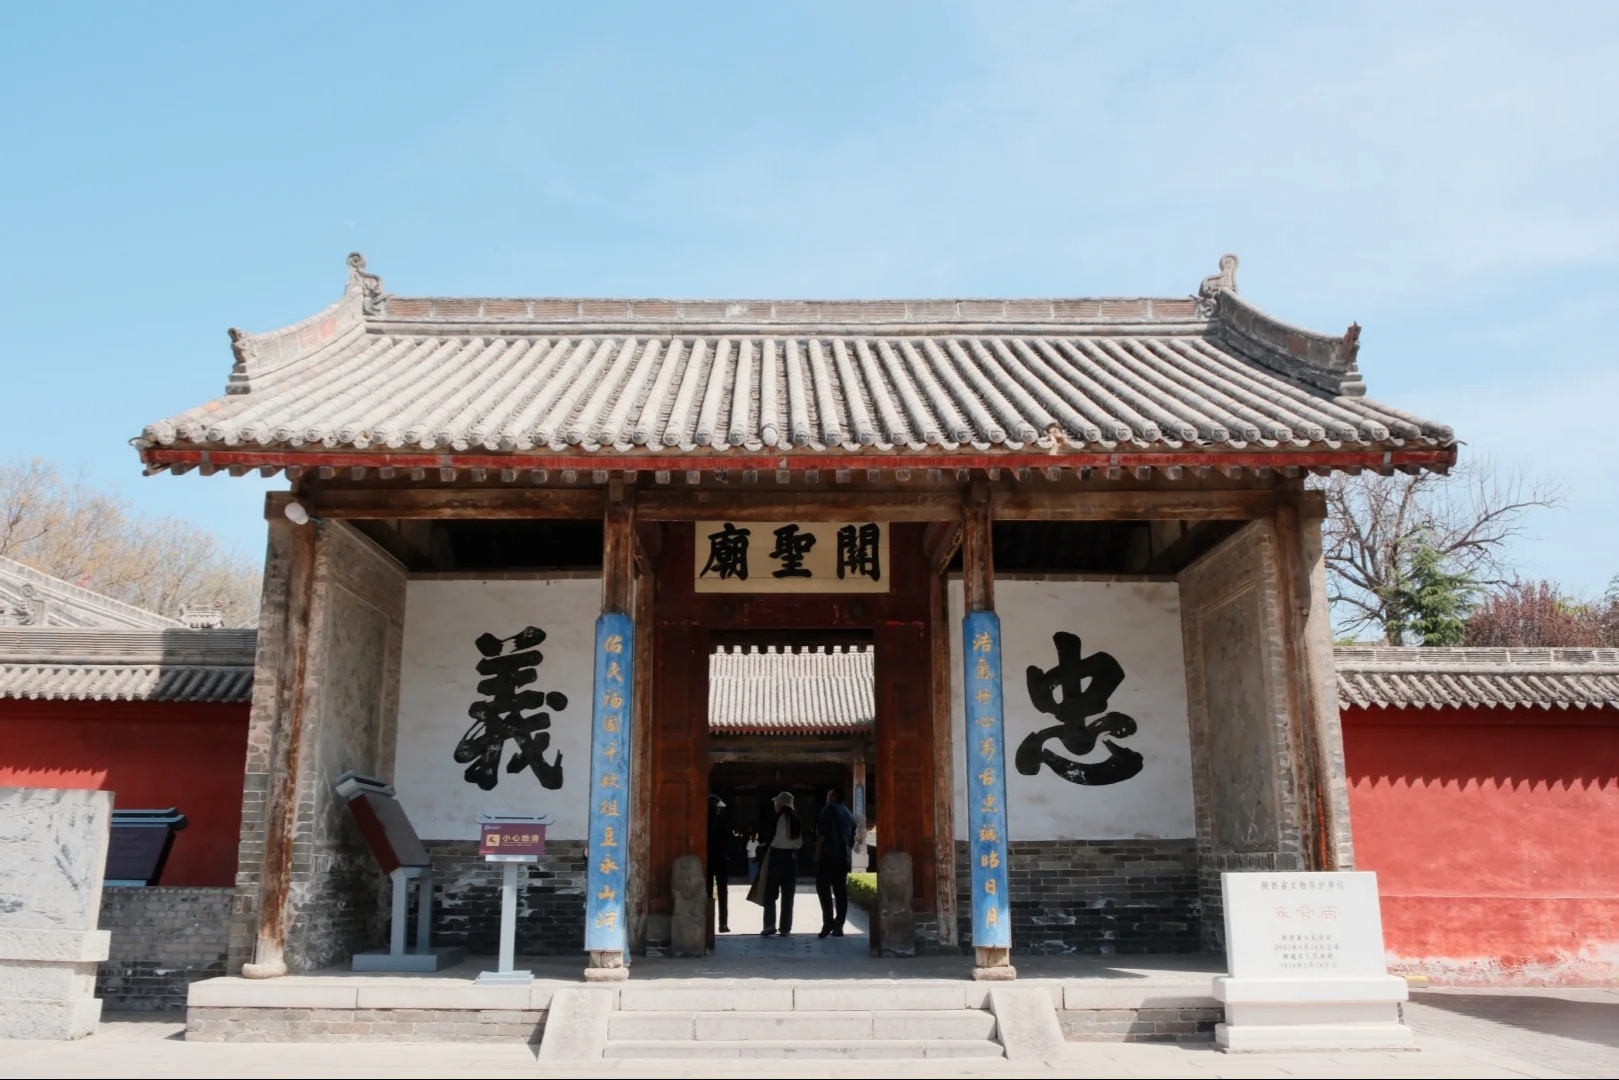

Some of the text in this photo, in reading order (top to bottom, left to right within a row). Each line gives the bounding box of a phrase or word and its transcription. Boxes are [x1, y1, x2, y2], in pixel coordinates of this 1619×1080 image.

[1015, 631, 1144, 786] 忠
[502, 834, 539, 843] 小心地滑
[1261, 880, 1345, 891] 陕西省文物保护单位
